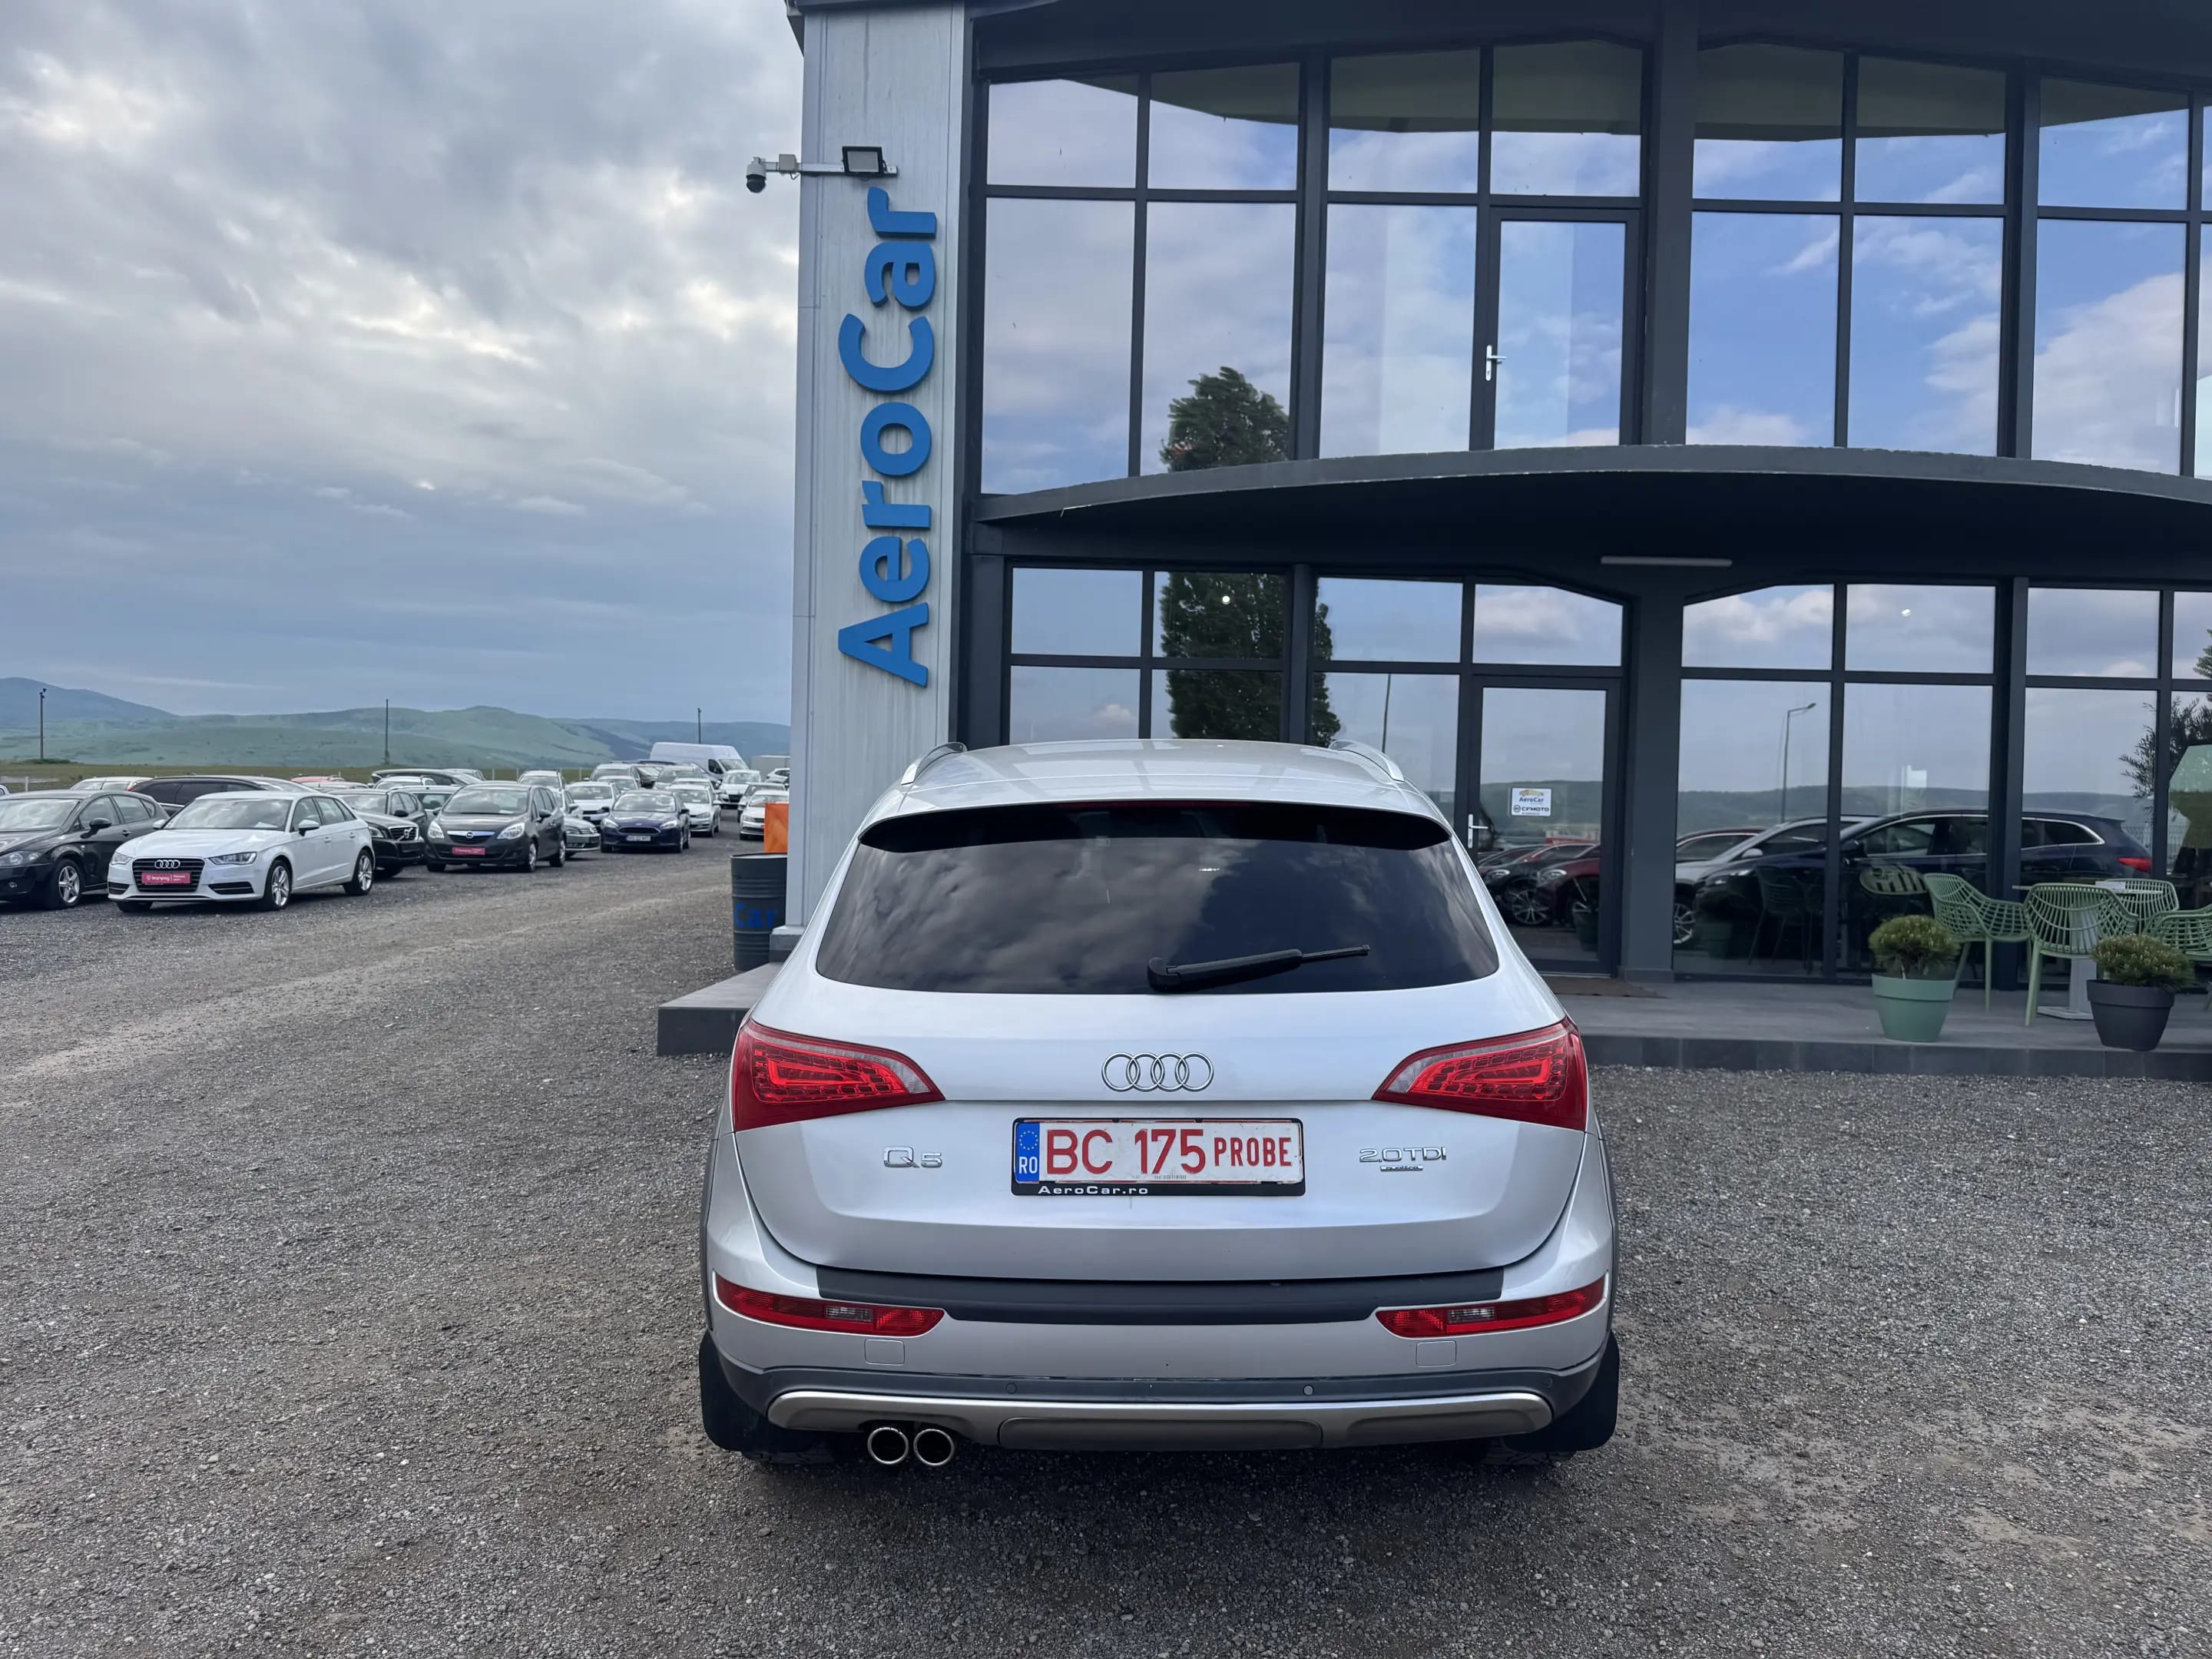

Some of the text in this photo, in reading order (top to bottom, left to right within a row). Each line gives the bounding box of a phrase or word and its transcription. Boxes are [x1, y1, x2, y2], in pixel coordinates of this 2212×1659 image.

[838, 187, 937, 687] AeroCar
[883, 1146, 942, 1167] Q5
[1047, 1128, 1293, 1174] BC 175 PROBE
[1019, 1156, 1038, 1174] RO
[1038, 1185, 1149, 1195] AeroCar.ro
